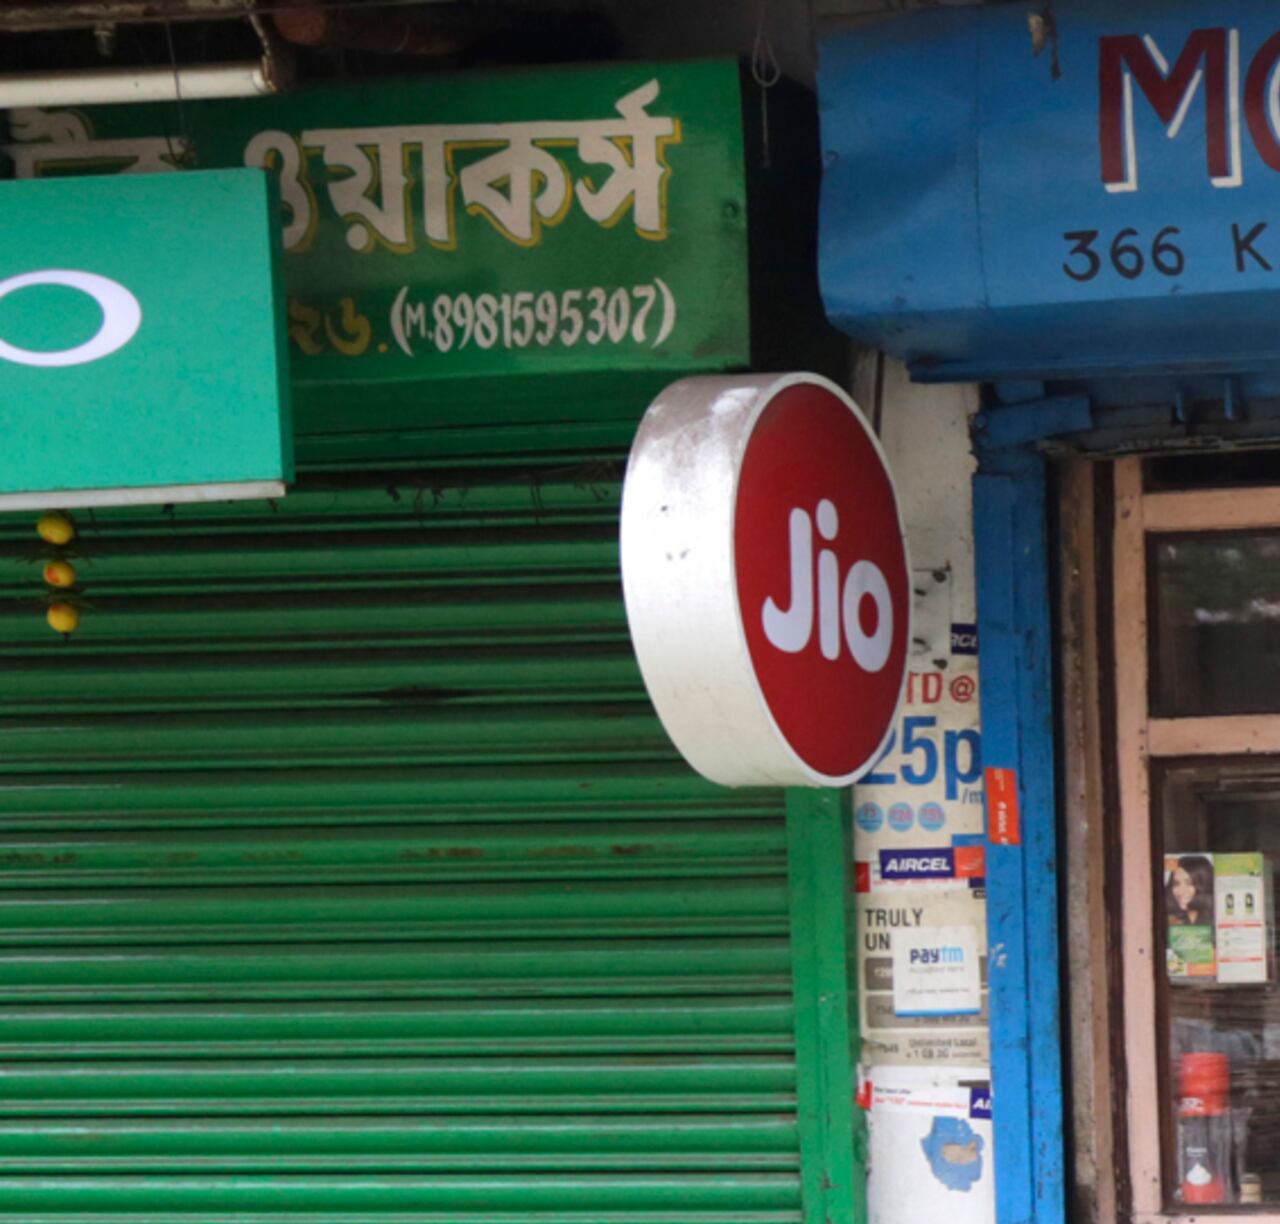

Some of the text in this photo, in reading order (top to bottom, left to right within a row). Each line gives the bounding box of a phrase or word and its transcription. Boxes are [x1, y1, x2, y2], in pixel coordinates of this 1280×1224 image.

[1061, 226, 1185, 281] 366
[761, 498, 894, 673] Jio
[885, 857, 951, 872] AIRCEL
[865, 908, 923, 927] TRULY
